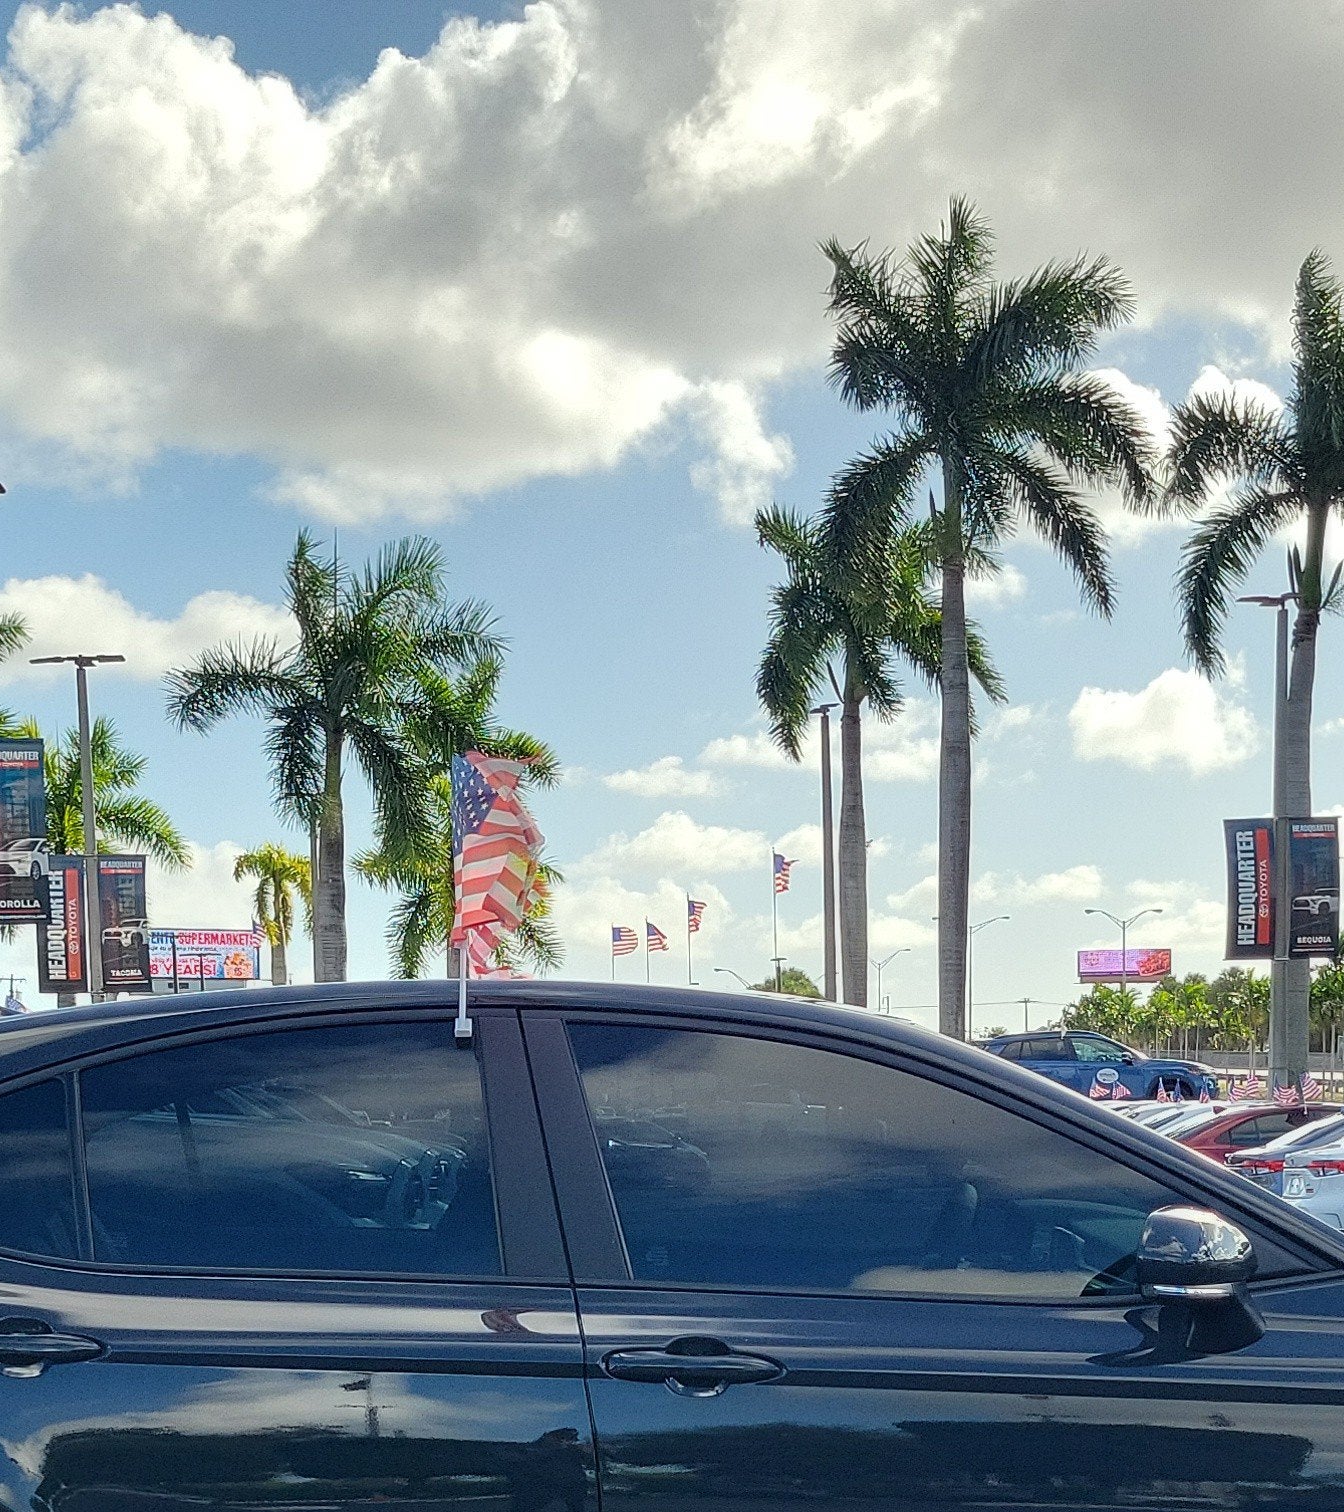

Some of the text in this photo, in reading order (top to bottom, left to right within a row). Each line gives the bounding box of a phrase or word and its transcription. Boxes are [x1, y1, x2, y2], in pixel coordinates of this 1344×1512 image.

[1236, 830, 1258, 946] HEADQUARTER
[1259, 860, 1269, 904] TOYOTA
[68, 899, 78, 936] TOYOTA
[1297, 935, 1332, 944] SEQUOIA
